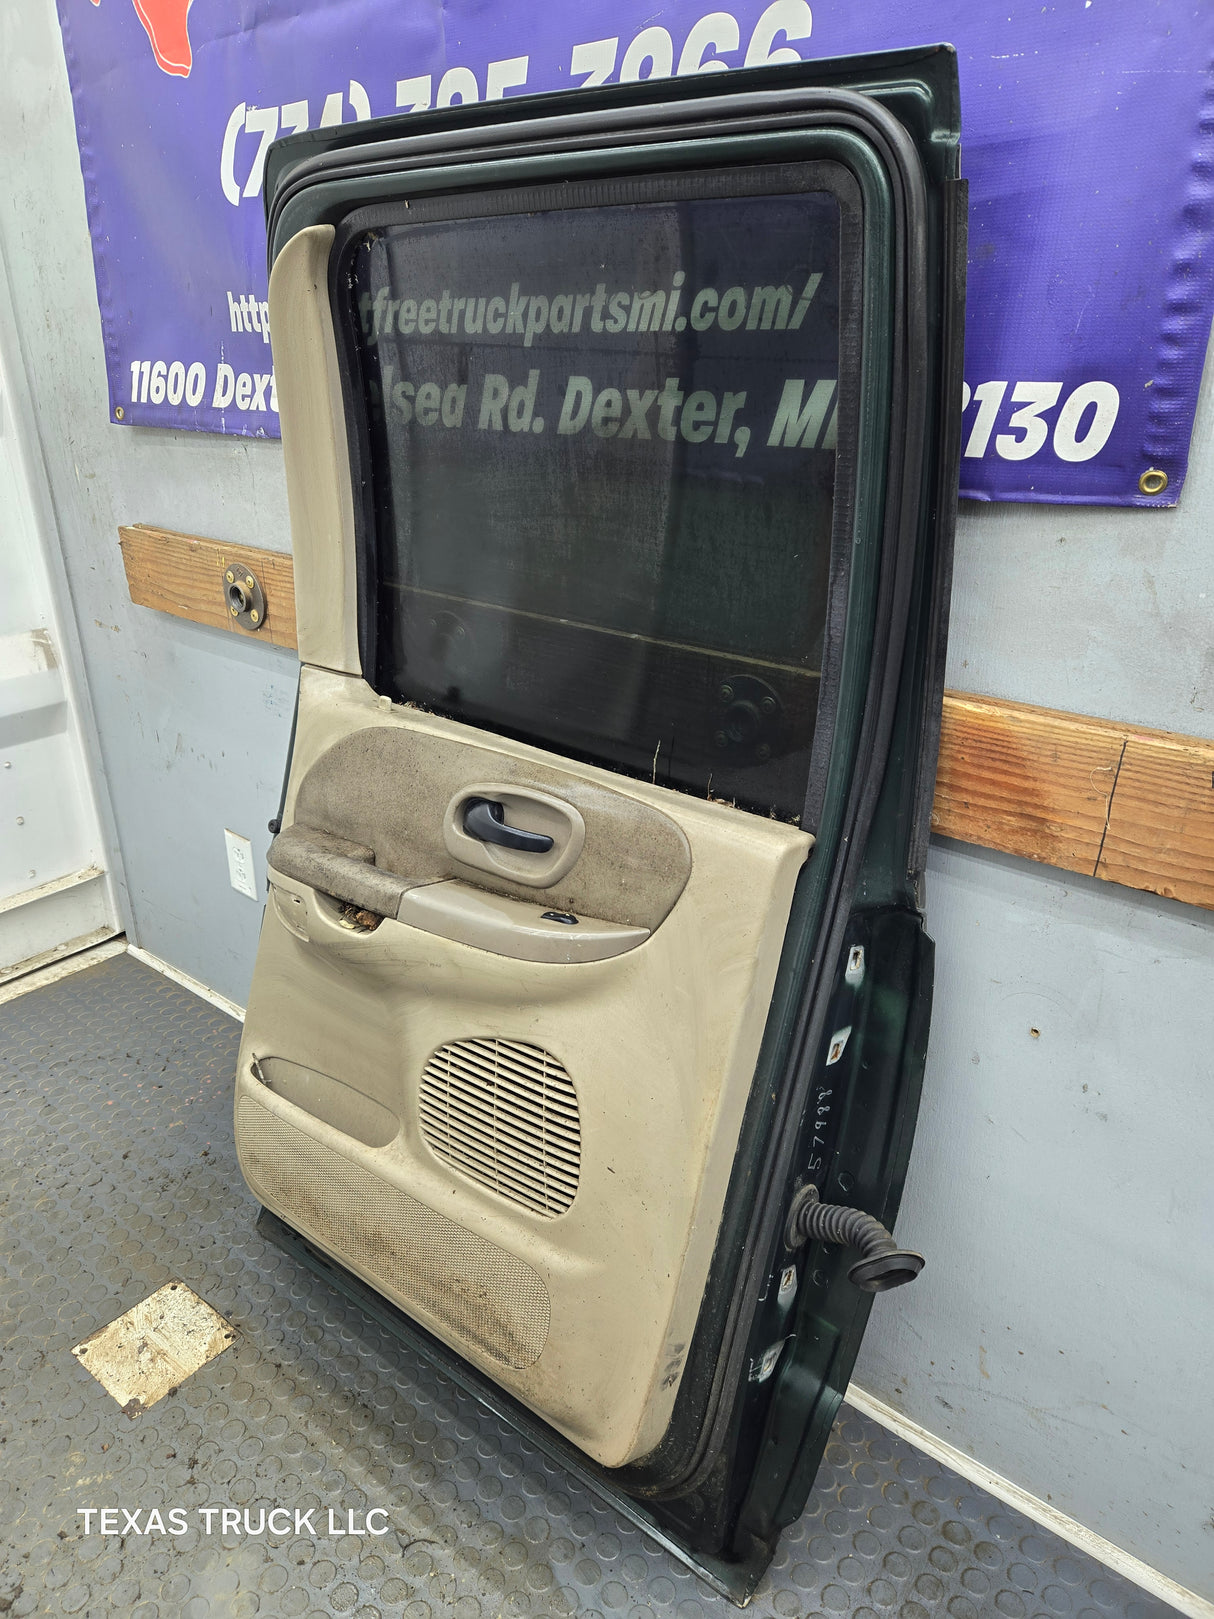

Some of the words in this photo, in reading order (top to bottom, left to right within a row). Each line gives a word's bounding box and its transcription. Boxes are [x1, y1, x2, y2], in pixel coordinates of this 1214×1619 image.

[130, 360, 206, 407] 11600
[478, 369, 544, 434] Rd.
[557, 375, 750, 457] Dexter,
[962, 380, 1120, 462] 130
